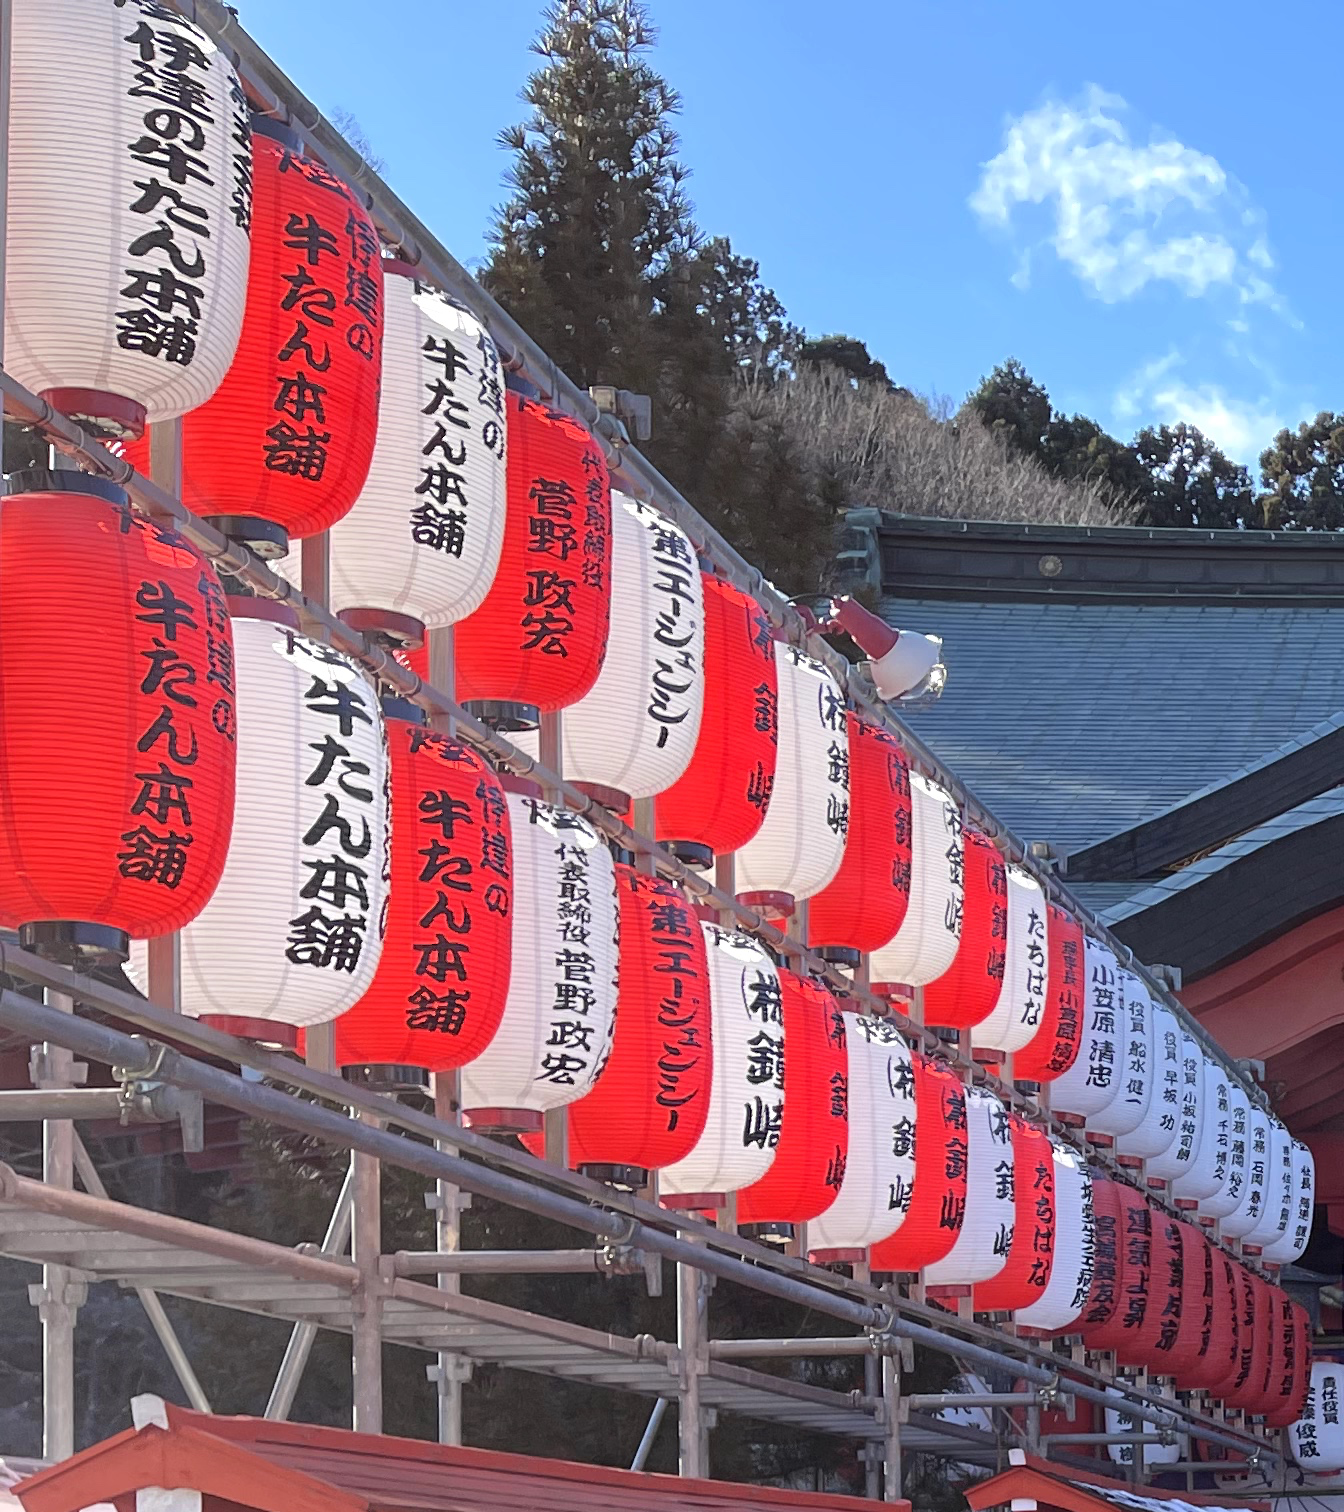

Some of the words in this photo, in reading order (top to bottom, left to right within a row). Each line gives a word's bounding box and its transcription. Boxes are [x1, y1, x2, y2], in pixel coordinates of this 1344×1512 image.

[262, 212, 339, 483] 牛たん本舗
[410, 333, 472, 559] 牛たん本舗
[116, 579, 199, 890] 牛たん本舗
[283, 674, 374, 975] 牛たん本舗
[404, 788, 475, 1036] 牛たん本舗
[1020, 907, 1048, 1027] たちばな
[1027, 1160, 1053, 1287] たちばな
